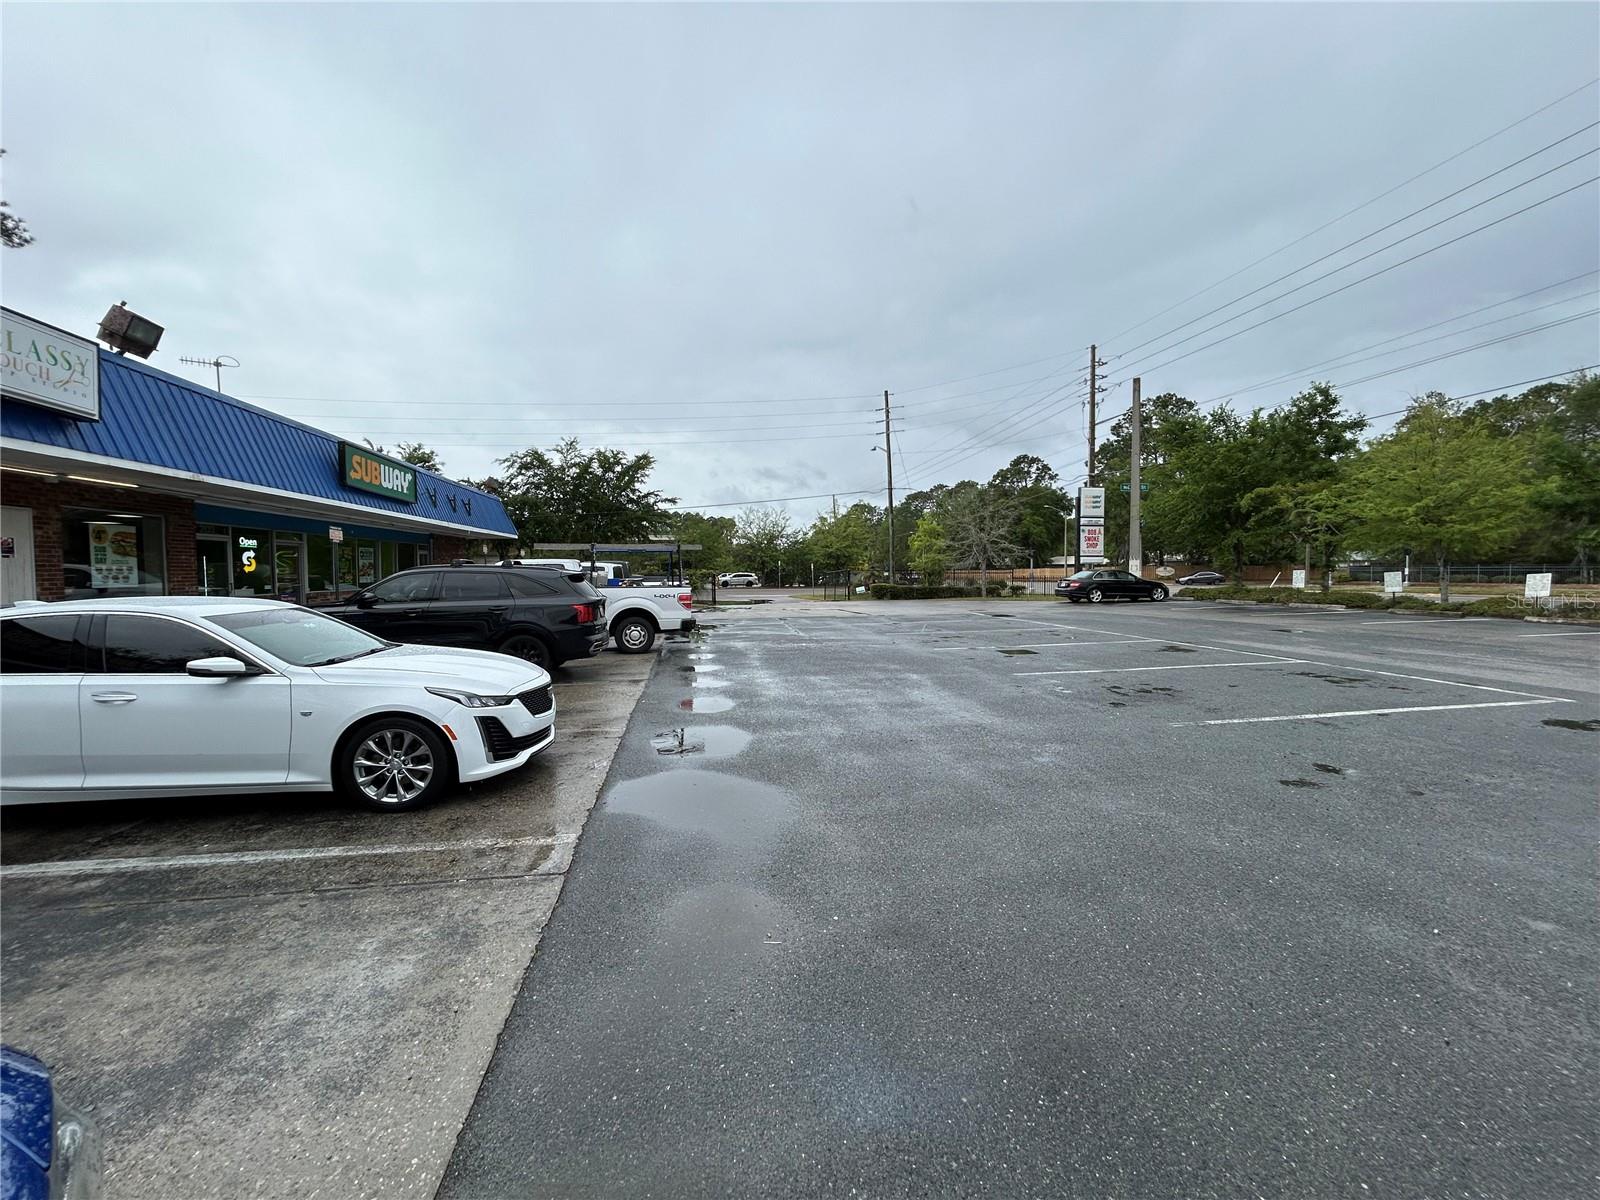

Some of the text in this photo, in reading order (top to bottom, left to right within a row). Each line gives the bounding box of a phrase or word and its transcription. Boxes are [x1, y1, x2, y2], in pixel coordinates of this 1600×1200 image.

[0, 330, 88, 377] LASSY
[0, 352, 50, 381] OUCH
[350, 454, 412, 493] SUBWAY
[239, 536, 258, 547] Open
[1084, 535, 1100, 543] SMOKE
